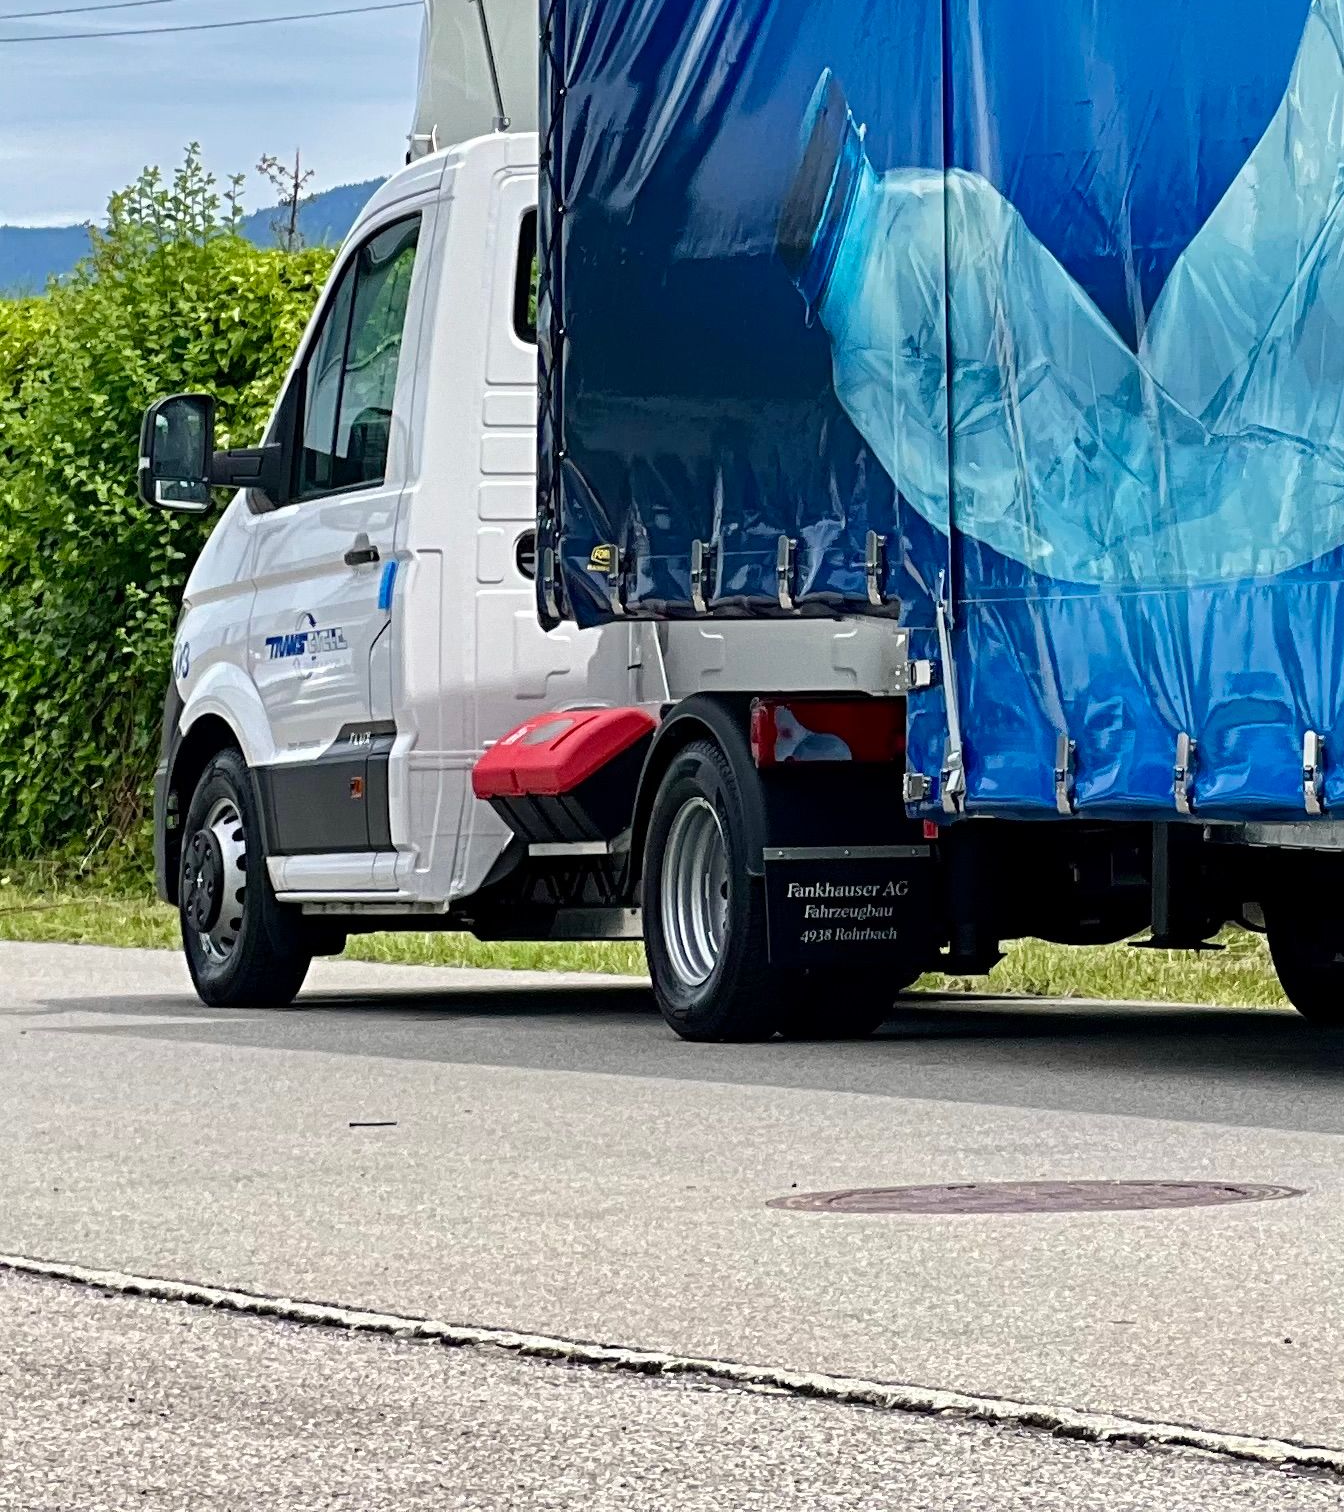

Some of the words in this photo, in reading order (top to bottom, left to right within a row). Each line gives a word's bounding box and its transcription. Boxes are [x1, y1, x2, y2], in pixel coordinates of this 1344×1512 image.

[786, 881, 881, 898] Fankhauser
[882, 880, 909, 896] AG
[804, 903, 893, 920] Fahrzeugbau
[800, 928, 832, 943] 4938
[834, 926, 897, 941] Rohrbach
